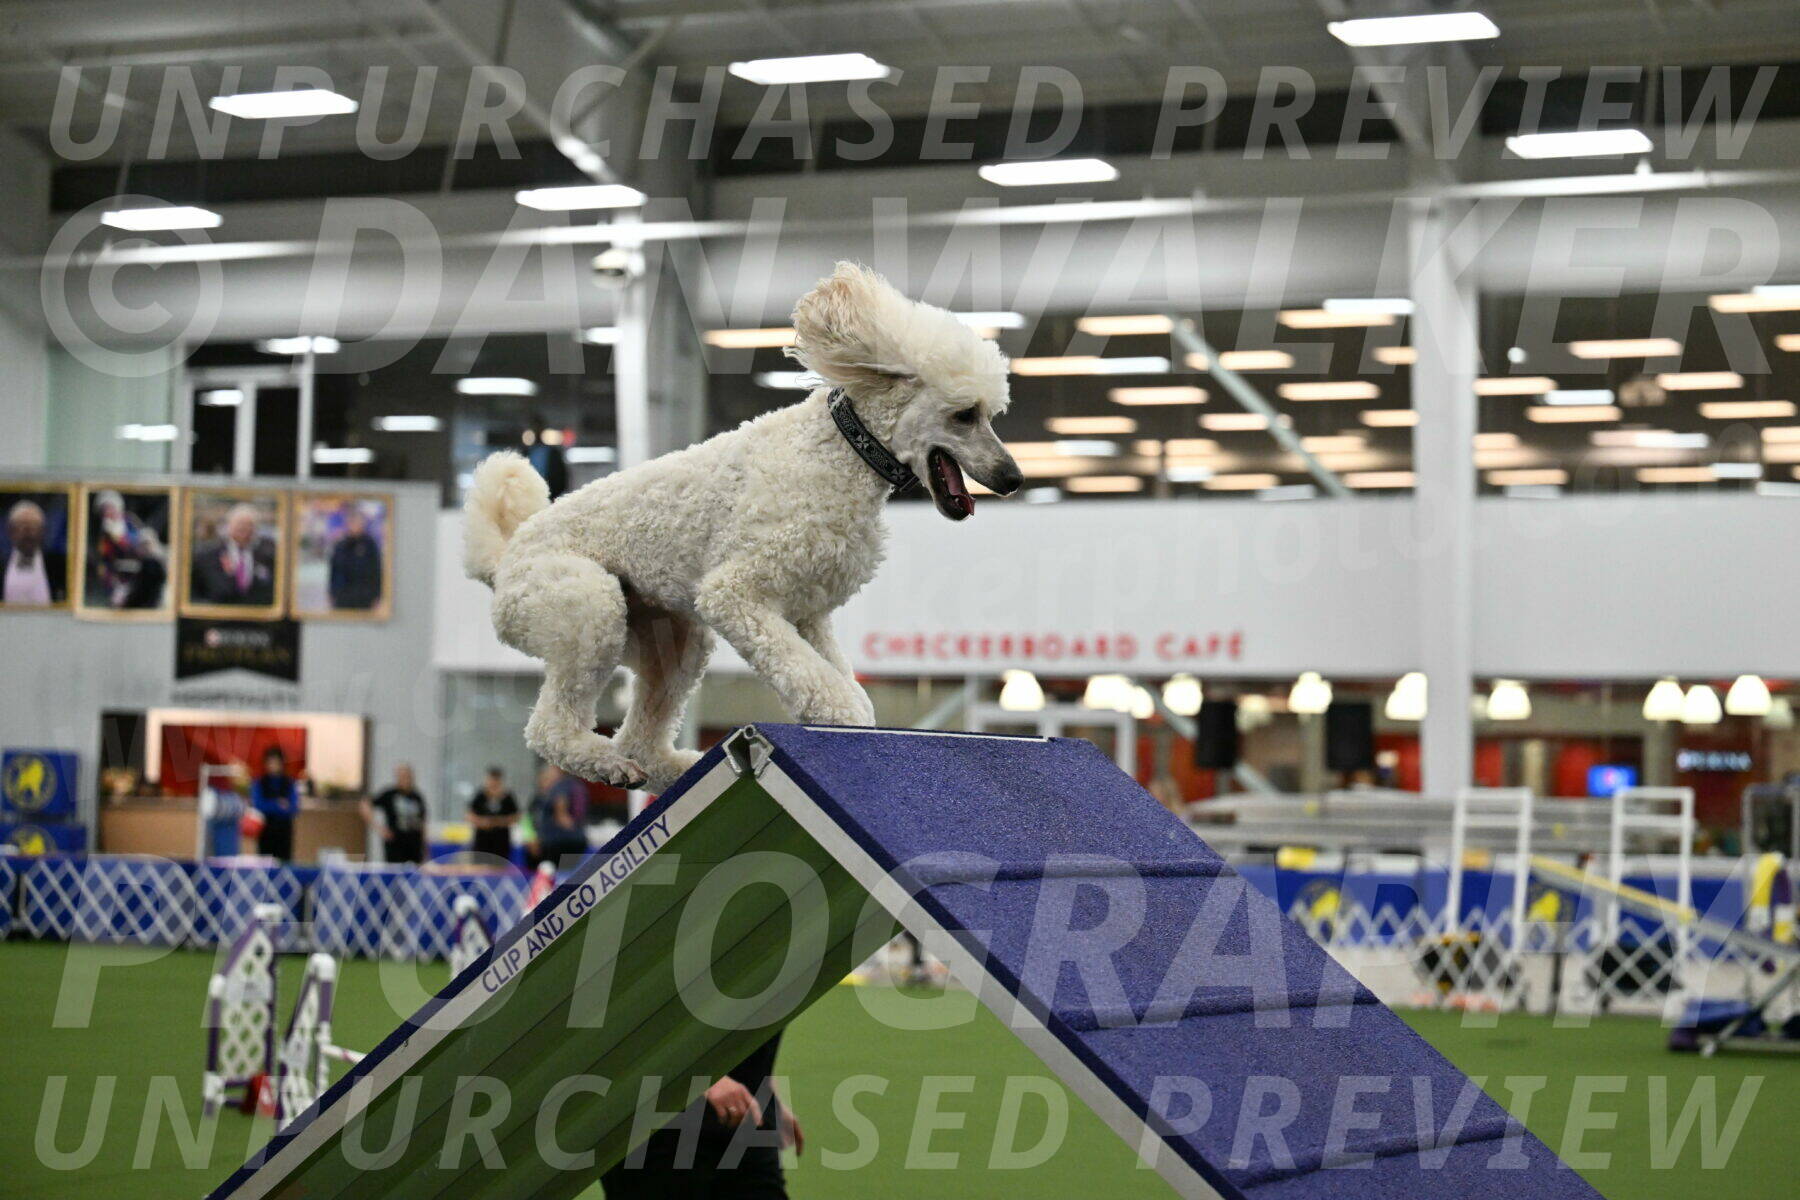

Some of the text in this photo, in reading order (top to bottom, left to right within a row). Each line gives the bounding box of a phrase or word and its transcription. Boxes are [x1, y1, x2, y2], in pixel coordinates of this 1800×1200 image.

[863, 632, 1136, 659] CHECKERBOARD
[482, 814, 671, 993] CLIP AND GO AGILITY
